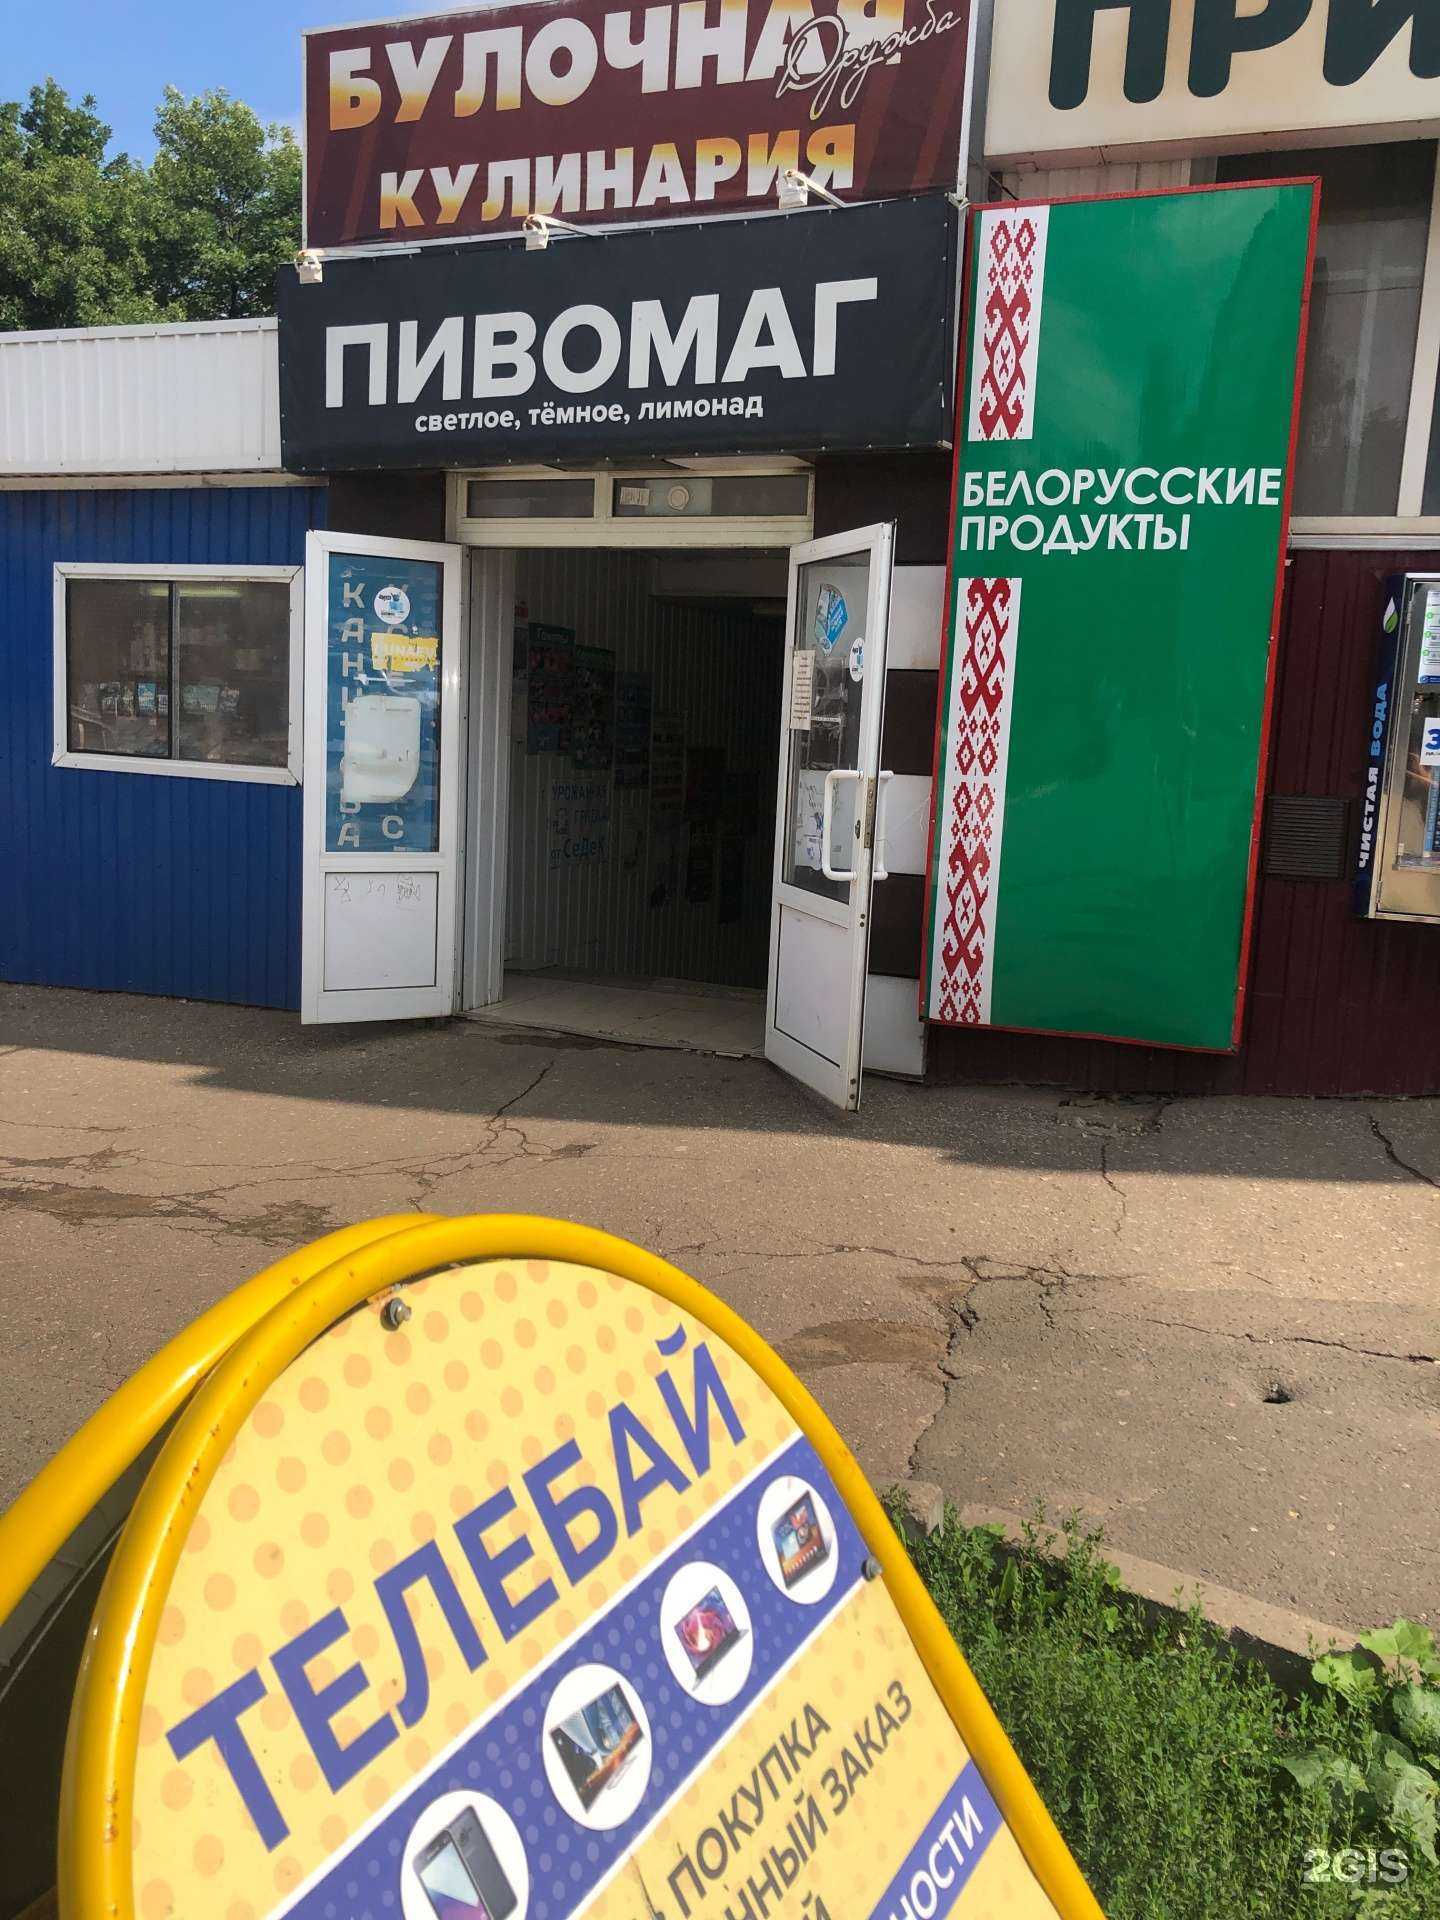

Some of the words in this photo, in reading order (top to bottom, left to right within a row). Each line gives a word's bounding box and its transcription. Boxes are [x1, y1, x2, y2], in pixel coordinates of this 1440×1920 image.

[329, 0, 905, 131] БУЛОЧНАЯ
[775, 0, 961, 120] Дружба
[379, 123, 856, 230] КУЛИНАРИЯ
[325, 276, 879, 409] ПИВОМАГ
[414, 409, 521, 433] светлое,
[528, 402, 631, 426] тёмное,
[638, 395, 764, 420] лимонад
[959, 512, 1191, 556] ПРОДУКТЫ
[961, 466, 1282, 508] БЕЛОРУССКИЕ
[1358, 766, 1379, 869] ЧИСТАЯ
[1370, 682, 1388, 757] ВОДА
[166, 1323, 749, 1853] ТЕЛЕБАЙ
[666, 1701, 832, 1919] ПОКУПКА
[820, 1679, 913, 1816] ЗАКАЗ
